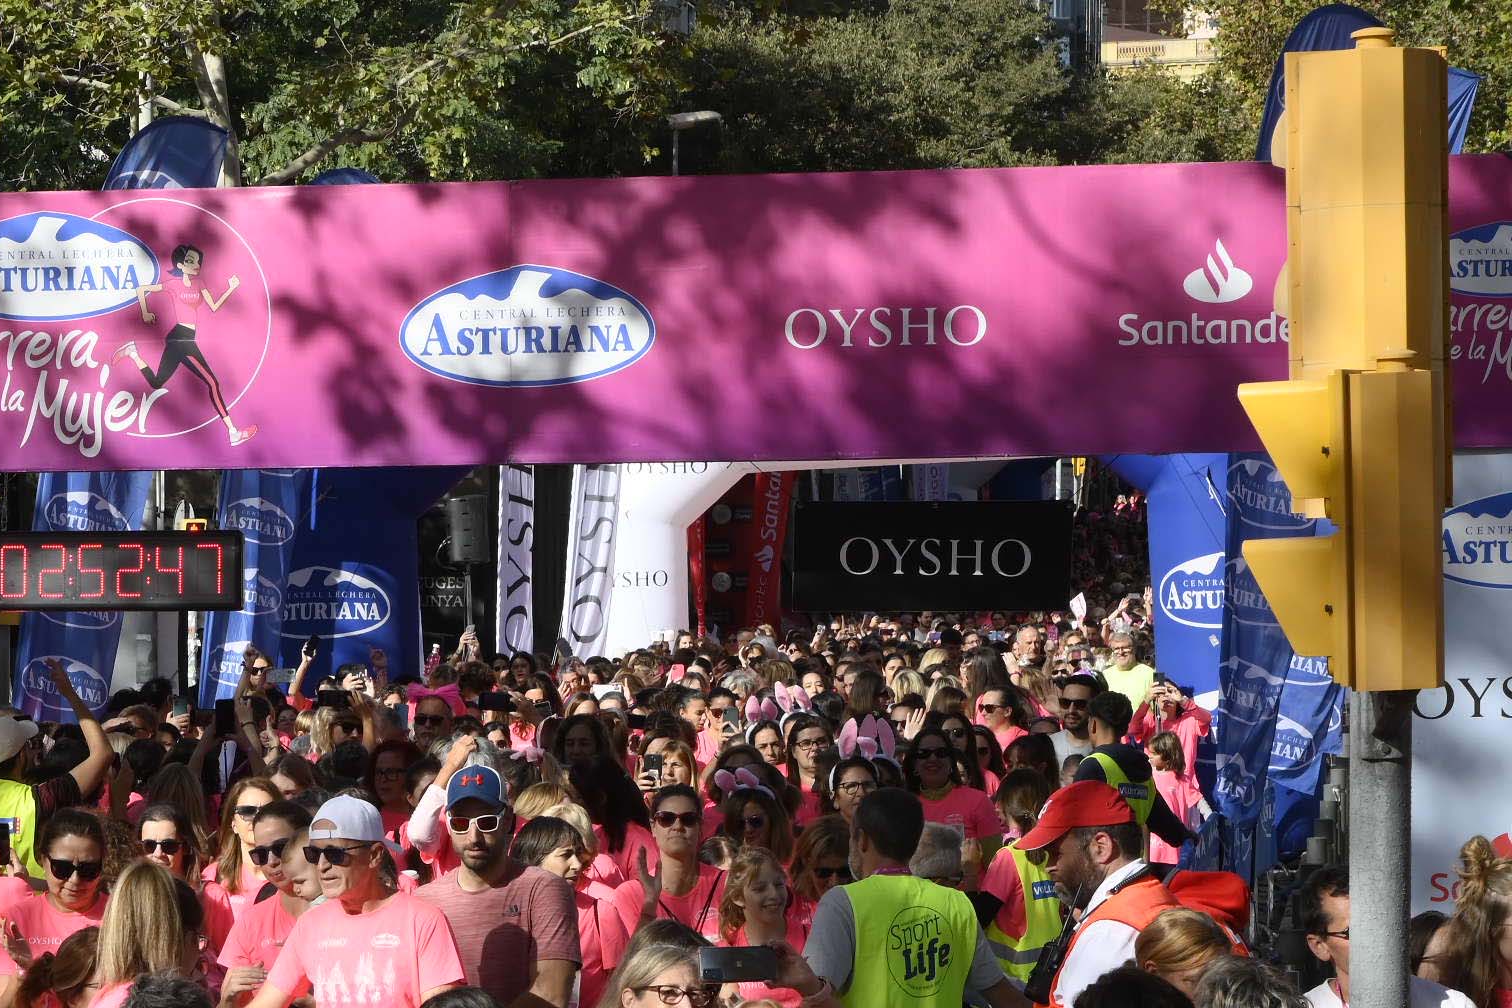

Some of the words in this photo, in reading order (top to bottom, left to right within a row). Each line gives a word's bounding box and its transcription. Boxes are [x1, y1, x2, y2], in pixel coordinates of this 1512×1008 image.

[62, 247, 136, 260] LECHERA
[419, 312, 636, 357] ASTURIANA
[459, 308, 535, 321] CENTRAL
[545, 305, 626, 318] LECHERA
[784, 304, 988, 349] OYSHO
[0, 371, 25, 412] la
[19, 363, 169, 458] Mujer
[0, 543, 223, 599] 02:52:47
[838, 536, 1032, 578] OYSHO
[1166, 581, 1225, 610] ASTU
[890, 914, 942, 950] Sport
[902, 937, 951, 981] Life
